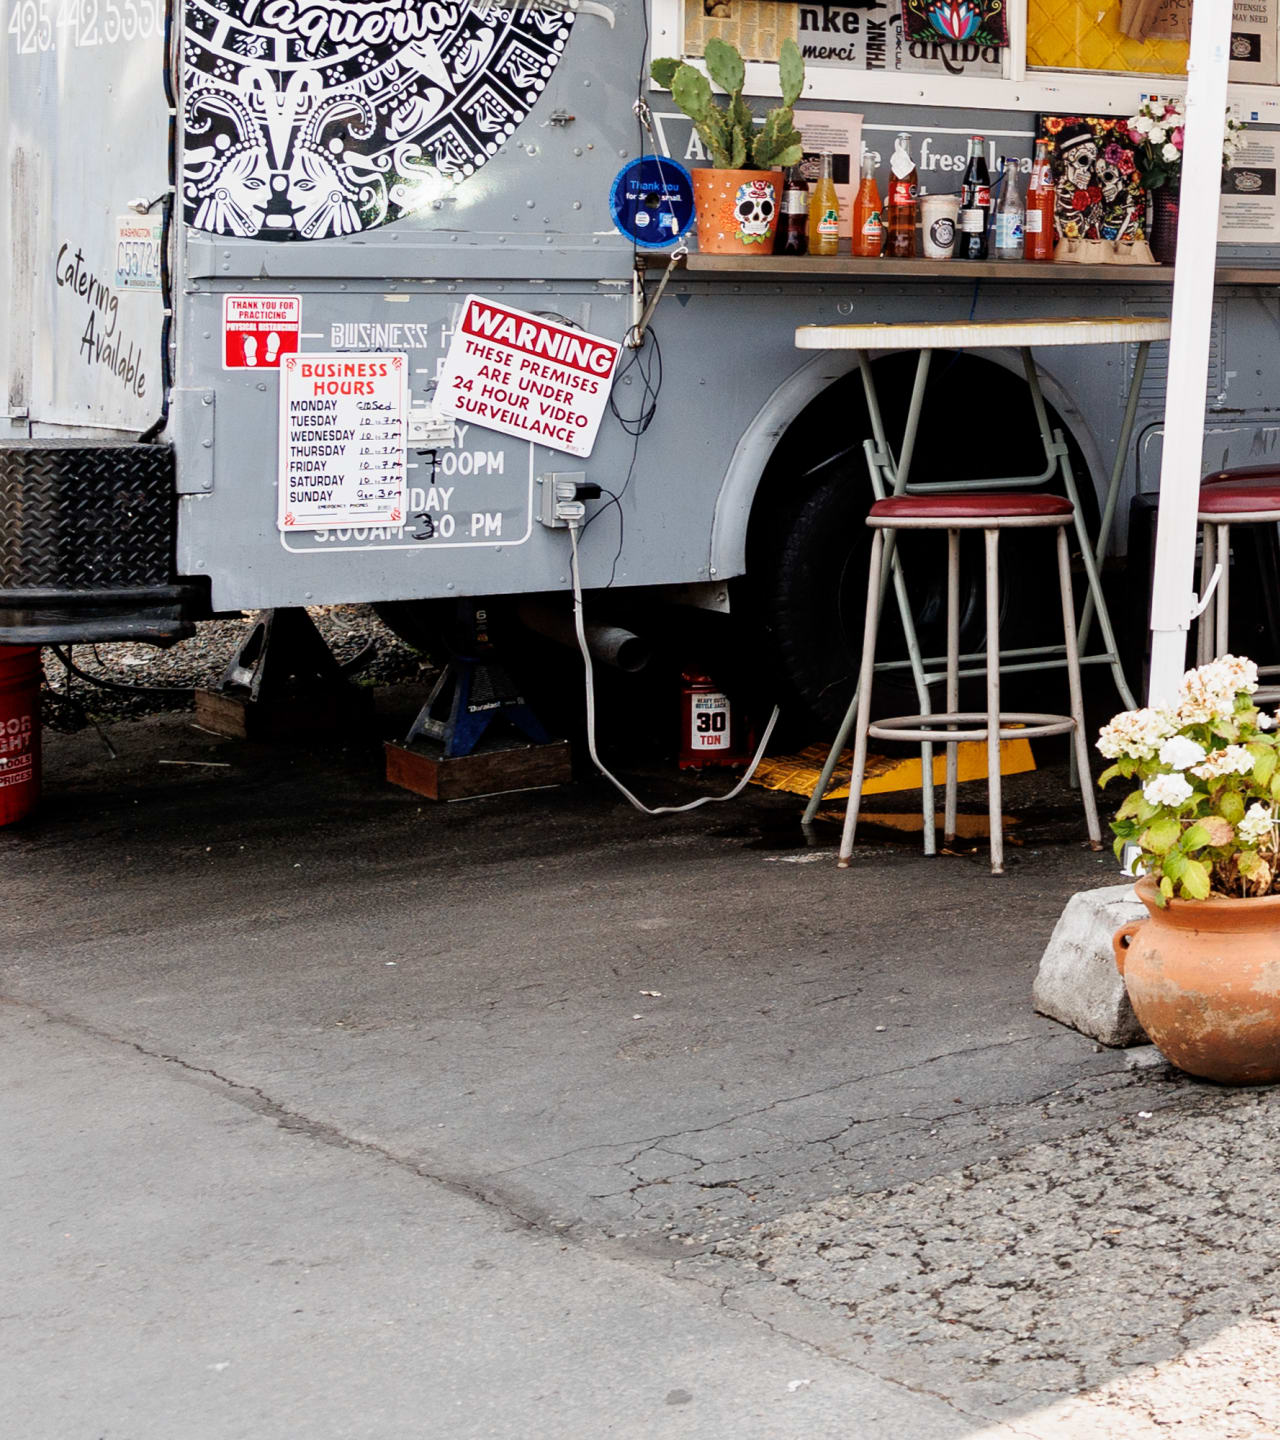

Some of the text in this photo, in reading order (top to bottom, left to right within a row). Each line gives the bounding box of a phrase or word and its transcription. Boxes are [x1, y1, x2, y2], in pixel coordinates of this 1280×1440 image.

[800, 6, 860, 35] nke
[1249, 15, 1268, 24] NEED
[866, 18, 887, 71] THANK
[802, 42, 855, 61] merci
[630, 180, 660, 191] Thank
[626, 192, 637, 200] for
[55, 243, 118, 338] Catering
[232, 301, 294, 310] THANK YOU FOR
[239, 311, 286, 320] PRACTICING
[470, 304, 615, 375] WARNING
[80, 310, 146, 398] Available
[465, 340, 600, 395] THESE PREMISES
[313, 381, 375, 397] HOURS
[477, 365, 574, 406] ARE UNDER
[290, 400, 338, 412] MONDAY
[451, 375, 589, 429] 24 HOUR VIDEO
[291, 415, 338, 427] TUESDAY
[454, 395, 576, 444] SURVEILLANCE
[290, 429, 355, 442] WEDNESDAY
[290, 445, 346, 457] THURSDAY
[290, 461, 327, 472] FRIDAY
[290, 475, 345, 488] SATURDAY
[290, 490, 334, 503] SUNDAY
[696, 711, 726, 733] 30
[699, 735, 721, 746] TON
